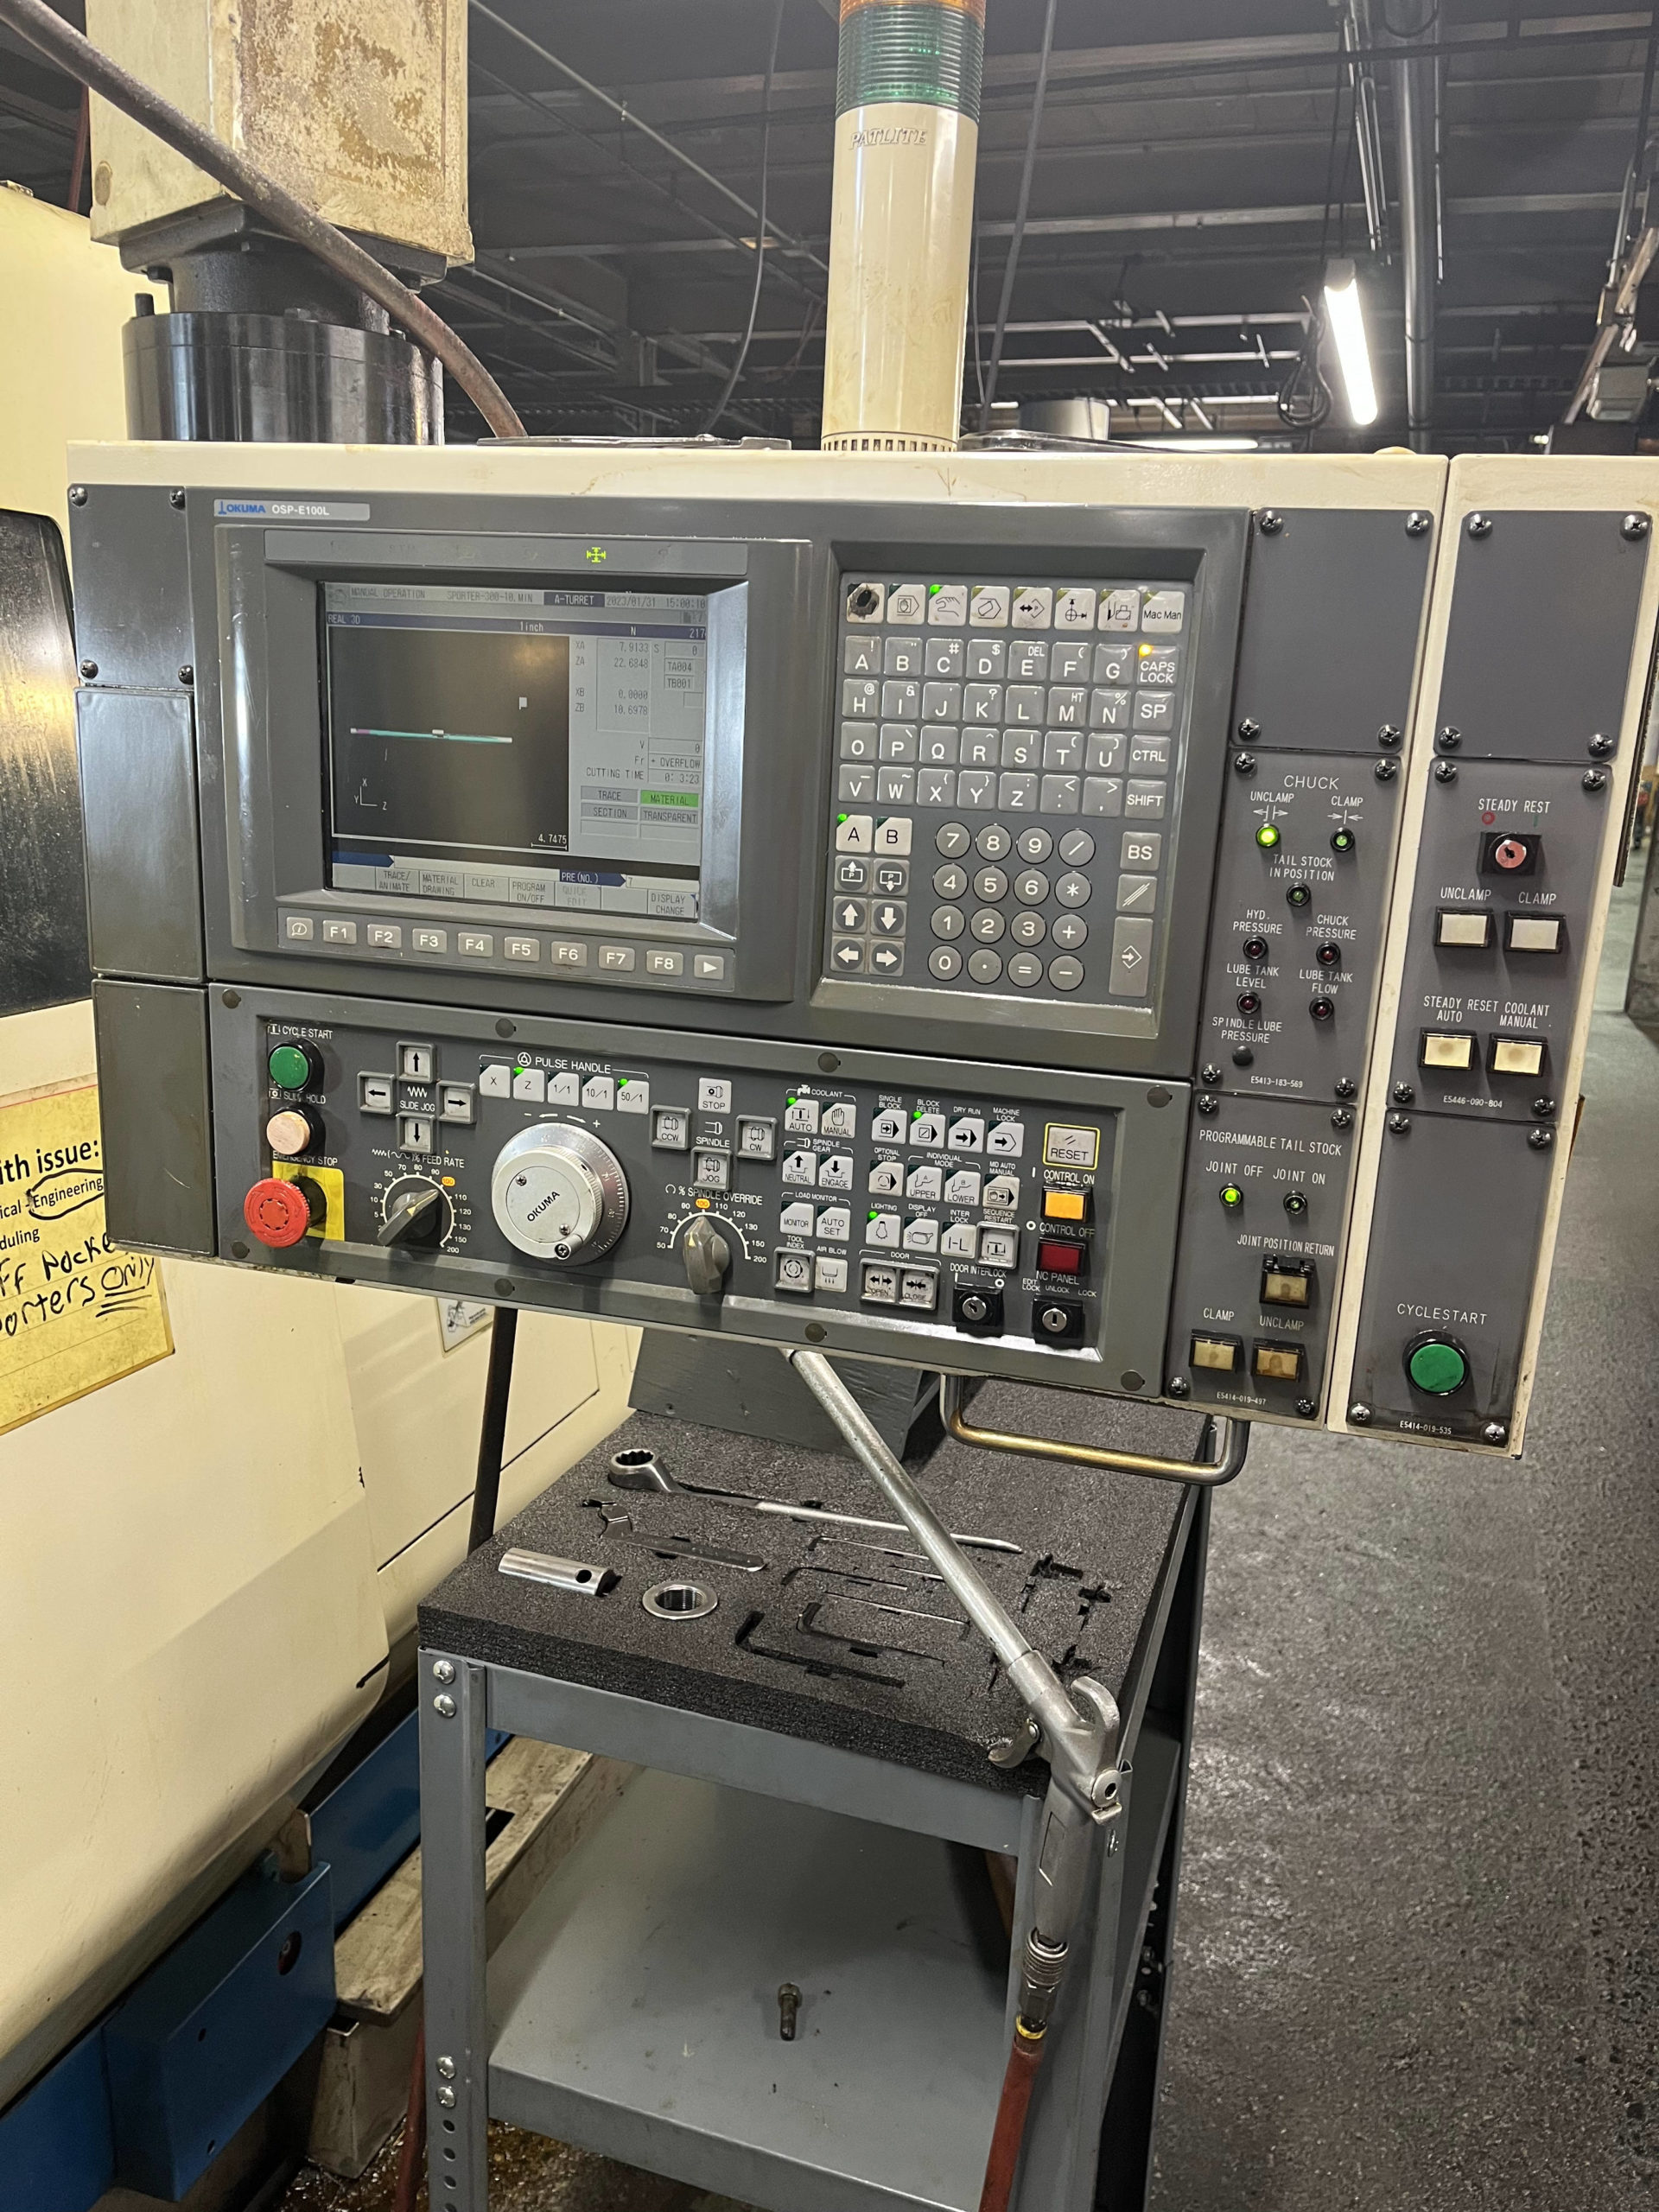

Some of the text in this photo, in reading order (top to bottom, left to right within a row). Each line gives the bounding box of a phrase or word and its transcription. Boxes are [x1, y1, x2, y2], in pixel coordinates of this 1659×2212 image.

[848, 127, 929, 150] PATLITE
[226, 504, 330, 516] OKUMA OSP-E100L
[383, 588, 425, 599] OPERATION
[554, 594, 594, 605] A-TURRET
[607, 596, 656, 607] 2023/01/31
[1143, 610, 1182, 620] Mac Man
[1140, 661, 1175, 671] CAPS
[1140, 673, 1174, 683] LOCK
[1140, 703, 1166, 719] SP
[1132, 750, 1166, 762] CTRL
[660, 757, 701, 768] OVERFLOW
[586, 766, 645, 780] CUTTING TIME
[1283, 775, 1340, 790] CHUCK
[598, 790, 690, 805] TRACE MATERIAL
[1127, 795, 1164, 807] SHIFT
[1250, 791, 1294, 803] UNCLAMP
[1331, 796, 1363, 807] CLAMP
[1478, 798, 1551, 814] STEADY REST
[593, 807, 697, 823] SECTION TRANSPARENT
[1128, 845, 1153, 860] BS
[1274, 854, 1332, 868] TAIL STOCK
[423, 874, 459, 886] MATERIAL
[1269, 868, 1335, 881] IN POSITION
[378, 881, 410, 893] ANIMATE
[472, 878, 495, 888] CLEAR
[512, 881, 546, 893] PROGRAM
[423, 885, 455, 896] DRAWING
[1440, 887, 1557, 906] UNCLAMP CLAMP
[517, 893, 545, 903] ON/OFF
[651, 893, 686, 904] DISPLAY
[656, 905, 684, 916] CHANGE
[1317, 914, 1349, 926] CHUCK
[330, 926, 346, 938] F1
[1233, 921, 1282, 934] PRESSURE
[1306, 927, 1357, 940] PRESSURE
[374, 931, 393, 944] F2
[420, 935, 439, 947] F3
[466, 939, 484, 951] F4
[512, 943, 531, 956] F5
[559, 948, 579, 961] F6
[606, 952, 626, 965] F7
[654, 957, 674, 969] F8
[1227, 963, 1280, 976] LUBE TANK
[1300, 969, 1353, 983] LUBE TANK
[1236, 977, 1267, 988] LEVEL
[1312, 983, 1338, 995] FLOW
[1424, 995, 1550, 1017] STEADY RESET COOLANT
[1211, 1017, 1282, 1032] SPINDLE LUBE
[1437, 1010, 1538, 1029] AUTO MANUAL
[283, 1026, 334, 1040] CYCLE START
[1221, 1031, 1270, 1043] PRESSURE
[535, 1057, 611, 1074] PULSE HANDLE
[811, 1089, 843, 1098] COOLANT
[878, 1095, 902, 1103] SINGLE
[399, 1101, 435, 1112] SLIDE JOG
[702, 1101, 726, 1109] STOP
[879, 1101, 901, 1109] BLOCK
[916, 1105, 940, 1114] DELETE
[993, 1107, 1020, 1116] MACHINE
[789, 1122, 812, 1132] AUTO
[823, 1126, 852, 1136] MANUAL
[661, 1132, 679, 1142] CCW
[696, 1137, 730, 1147] SPINDLE
[813, 1138, 841, 1147] SPINDLE
[1199, 1129, 1342, 1156] PROGRAMMABLE TAIL STOCK
[749, 1143, 762, 1152] CW
[874, 1147, 900, 1156] OPTIONAL
[1050, 1147, 1089, 1160] RESET
[36, 1140, 100, 1174] issue:
[318, 1153, 338, 1166] STOP
[444, 1157, 465, 1168] RATE
[926, 1152, 962, 1162] INDIVIDUAL
[934, 1160, 954, 1168] MODE
[1205, 1160, 1264, 1177] JOINT OFF
[702, 1174, 720, 1183] JOG
[785, 1173, 811, 1184] NEUTRAL
[1043, 1169, 1095, 1185] CONTROL ON
[1273, 1168, 1326, 1185] JOINT ON
[822, 1178, 849, 1188] ENGAGE
[33, 1177, 104, 1209] Engineering
[688, 1187, 763, 1205] SPINDLE OVERRIDE
[812, 1193, 837, 1202] MONITOR
[910, 1190, 936, 1198] UPPER
[947, 1193, 976, 1204] LOWER
[527, 1191, 561, 1222] OKUMA
[870, 1203, 898, 1211] LIGHTING
[908, 1203, 936, 1213] DISPLAY
[950, 1209, 970, 1217] INTER
[983, 1209, 1015, 1218] SEQUENCE
[784, 1218, 809, 1227] MONITOR
[822, 1217, 845, 1227] AUTO
[984, 1215, 1013, 1224] RESTART
[1039, 1222, 1096, 1237] CONTROL OFF
[829, 1247, 847, 1255] BLOW
[1236, 1234, 1335, 1256] JOINT POSITION RETURN
[891, 1251, 910, 1260] DOOR
[950, 1263, 1007, 1278] DOOR INTERLOCK
[1051, 1273, 1079, 1285] PANEL
[1203, 1307, 1235, 1322] CLAMP
[1396, 1303, 1487, 1325] CYCLESTART
[1259, 1315, 1305, 1332] UNCLAMP
